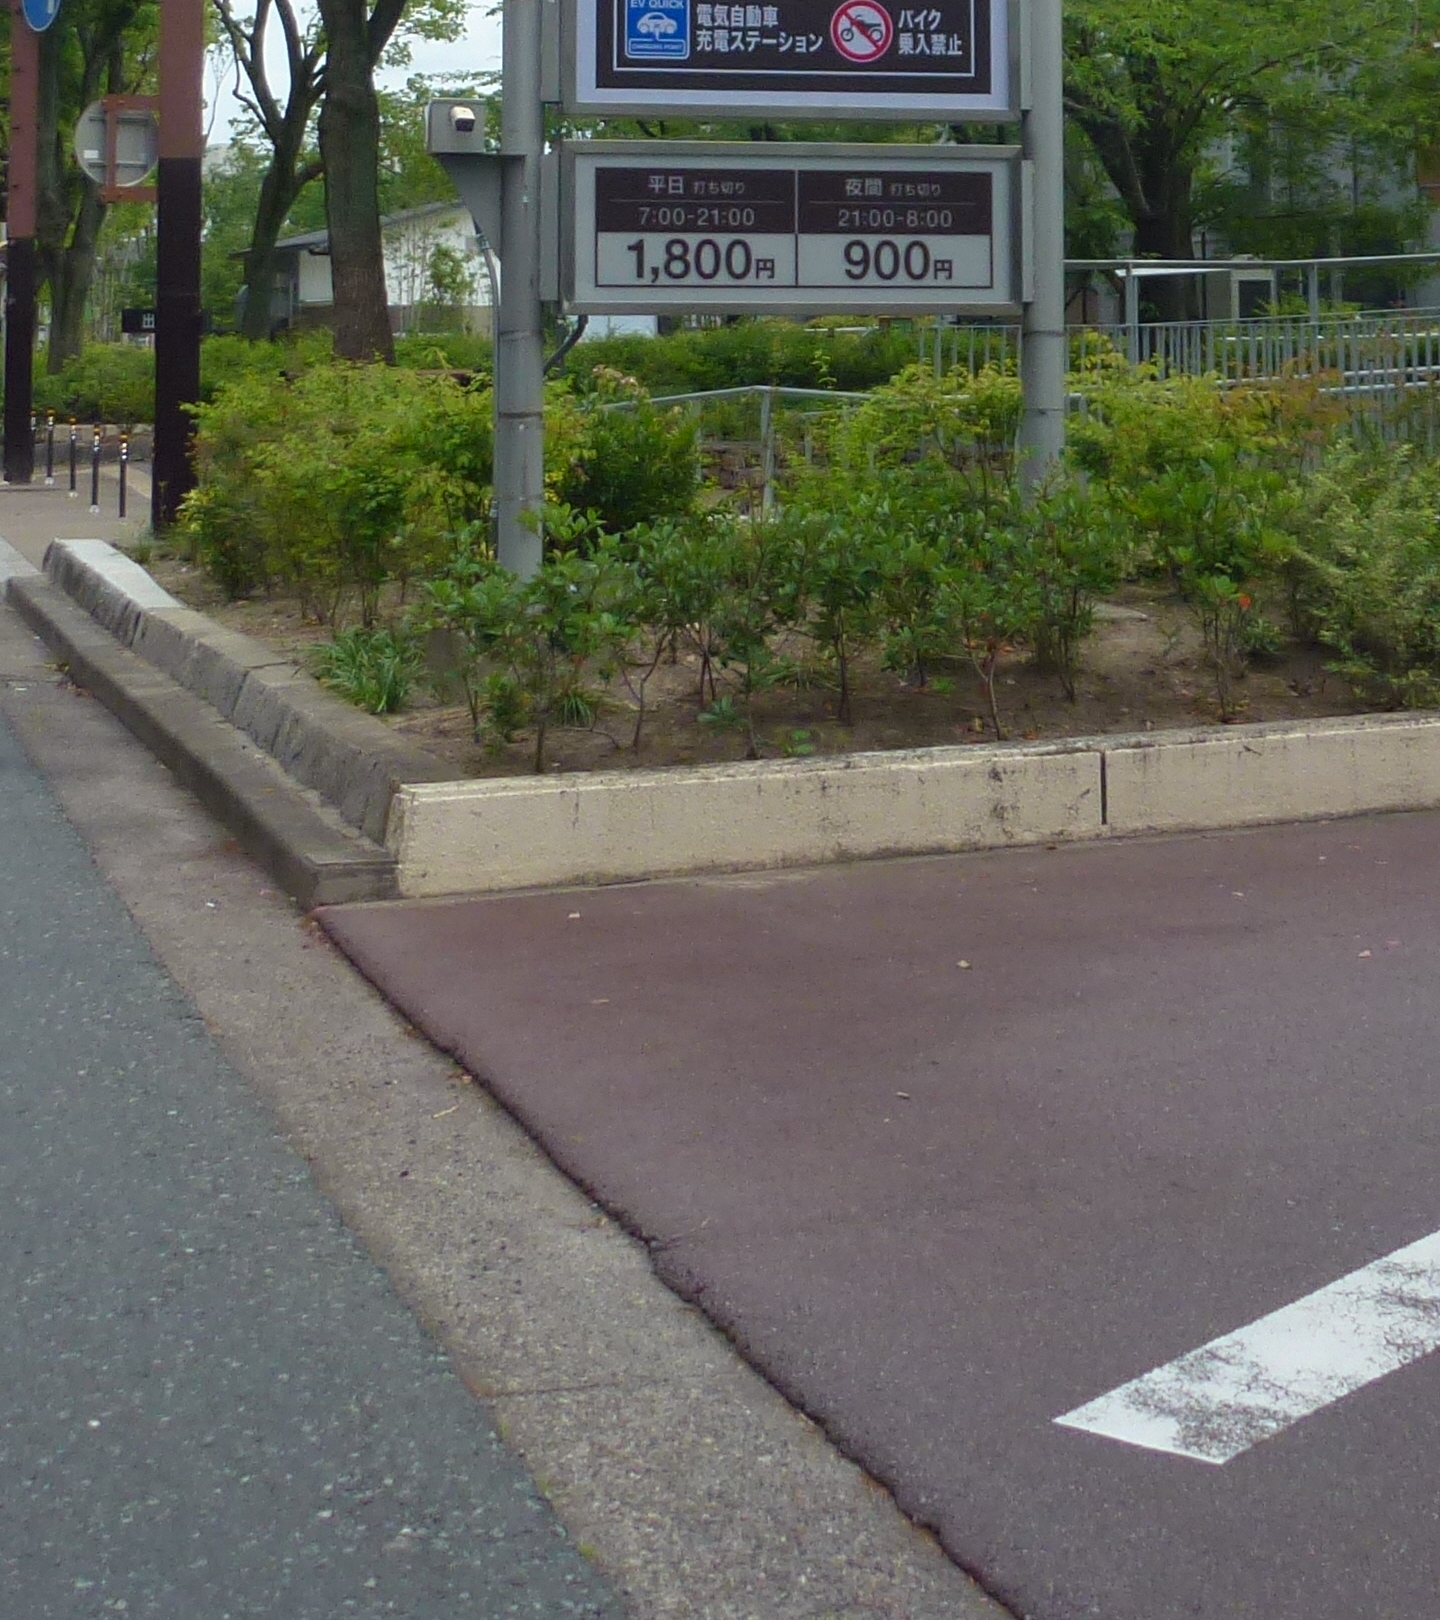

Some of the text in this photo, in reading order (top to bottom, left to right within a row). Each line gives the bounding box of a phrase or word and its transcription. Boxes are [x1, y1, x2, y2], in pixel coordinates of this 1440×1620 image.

[696, 3, 779, 28] 電気自動車
[898, 8, 942, 30] バイク
[695, 28, 824, 53] 充電ステーション
[898, 32, 963, 56] 乗入禁止
[647, 175, 746, 195] 平日 打ち切り
[844, 177, 942, 197] 夜間 打ち切り
[638, 206, 755, 226] 7:00-21:00
[838, 208, 953, 228] 21:00-8:00
[626, 238, 776, 284] 1,800円
[843, 239, 953, 282] 900円
